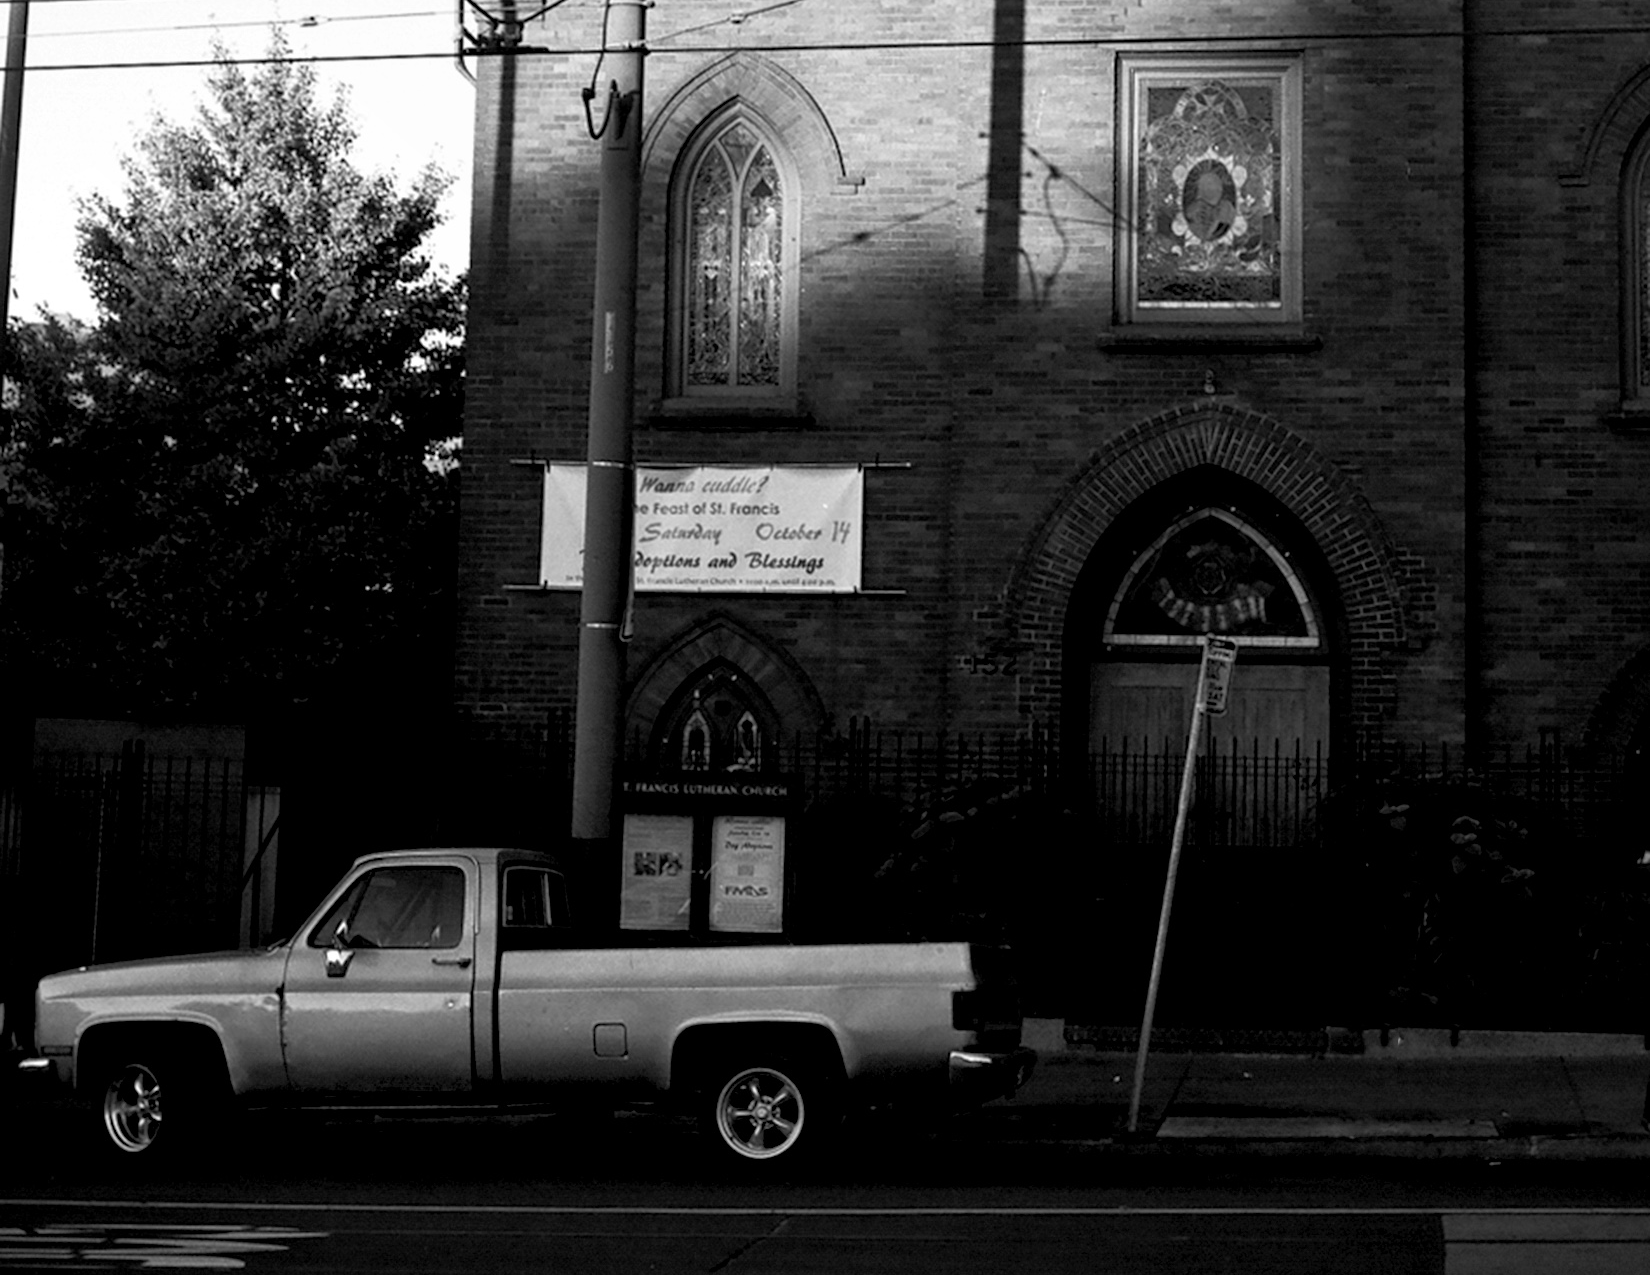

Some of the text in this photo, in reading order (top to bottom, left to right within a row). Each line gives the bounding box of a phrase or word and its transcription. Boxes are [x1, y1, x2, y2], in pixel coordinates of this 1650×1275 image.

[639, 476, 769, 493] Wanna cuddle?
[653, 502, 689, 515] Feast
[692, 502, 707, 515] of
[710, 502, 726, 515] St.
[730, 502, 780, 515] Francis
[638, 520, 851, 546] Saturday October 14
[634, 550, 824, 575] doptions and Blessings
[675, 577, 708, 585] Lutheran
[709, 577, 736, 585] Church
[635, 782, 679, 794] FRANCIS
[683, 783, 738, 795] LUTHERAN
[742, 785, 787, 796] CHURCH
